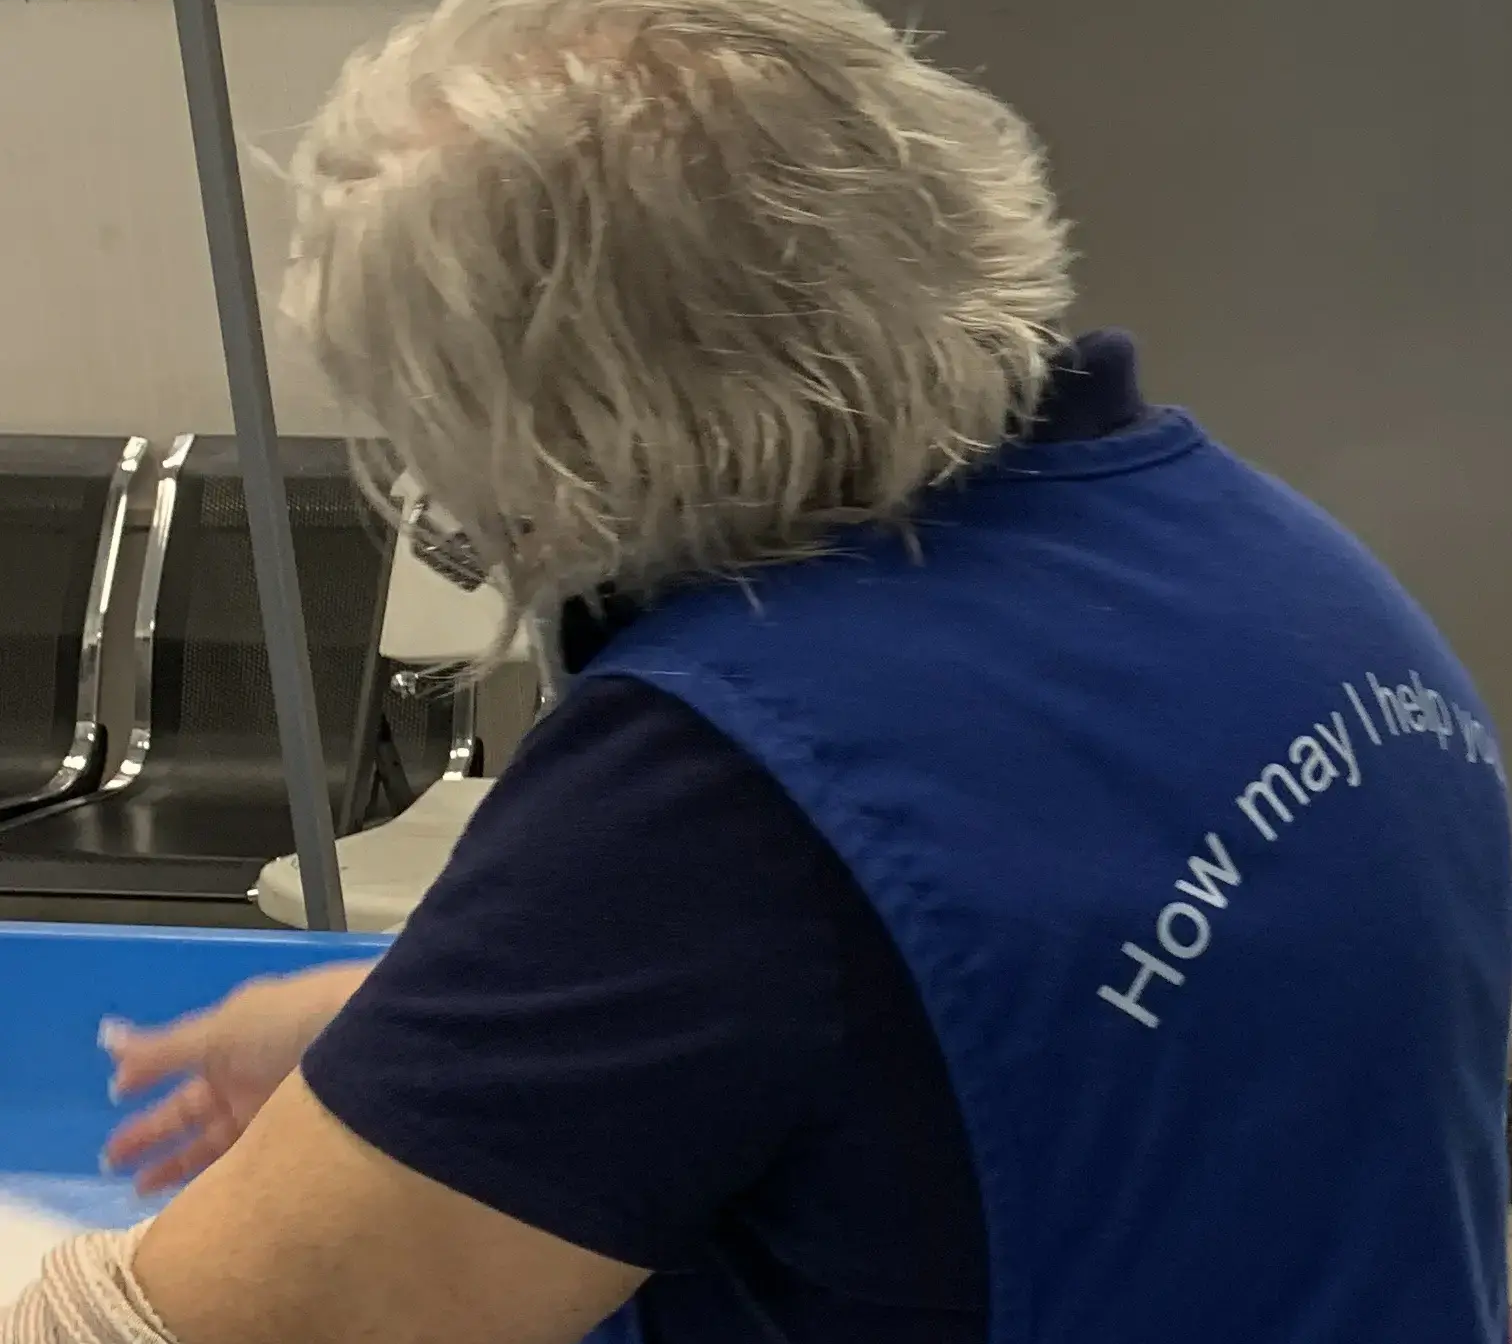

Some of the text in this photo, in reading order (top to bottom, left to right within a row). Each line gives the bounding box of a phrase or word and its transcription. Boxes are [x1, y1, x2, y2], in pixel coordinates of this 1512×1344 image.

[1097, 832, 1242, 1029] How
[1235, 711, 1361, 842] may
[1343, 682, 1382, 745] I
[1366, 669, 1453, 750] help
